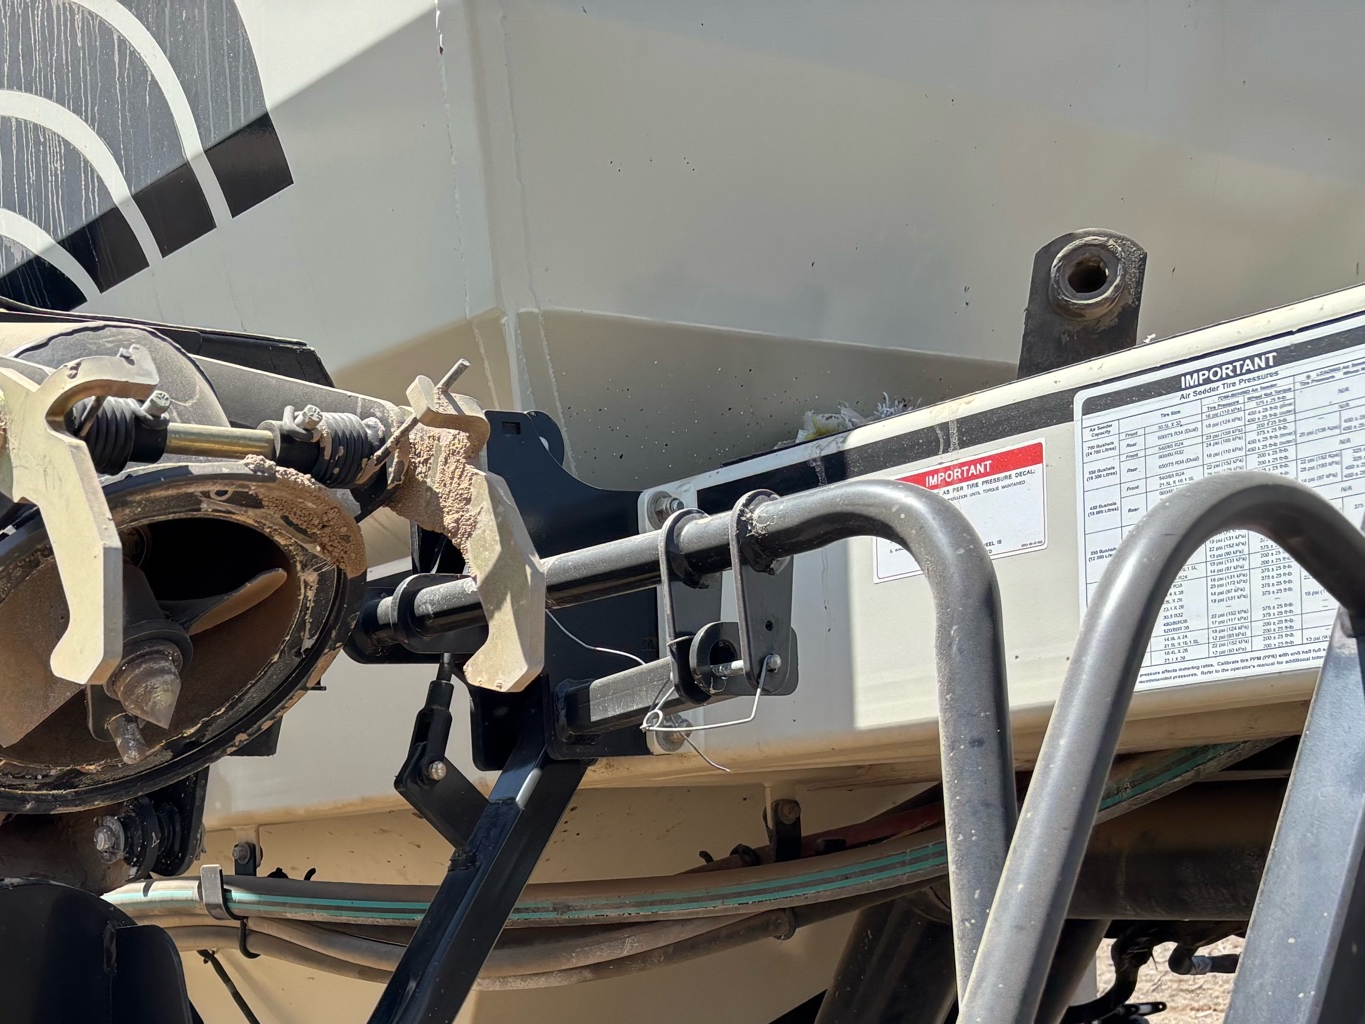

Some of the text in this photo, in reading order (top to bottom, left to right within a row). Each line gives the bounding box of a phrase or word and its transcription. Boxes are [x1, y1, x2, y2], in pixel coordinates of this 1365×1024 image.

[1180, 351, 1277, 389] IMPORTANT
[1179, 391, 1190, 401] Air
[1221, 379, 1236, 390] Tire
[1238, 369, 1279, 385] Pressures
[926, 460, 992, 487] IMPORTANT
[952, 485, 964, 494] PER
[966, 481, 980, 490] TIRE
[982, 474, 1013, 487] PRESSURE
[1015, 469, 1036, 478] DECAL:
